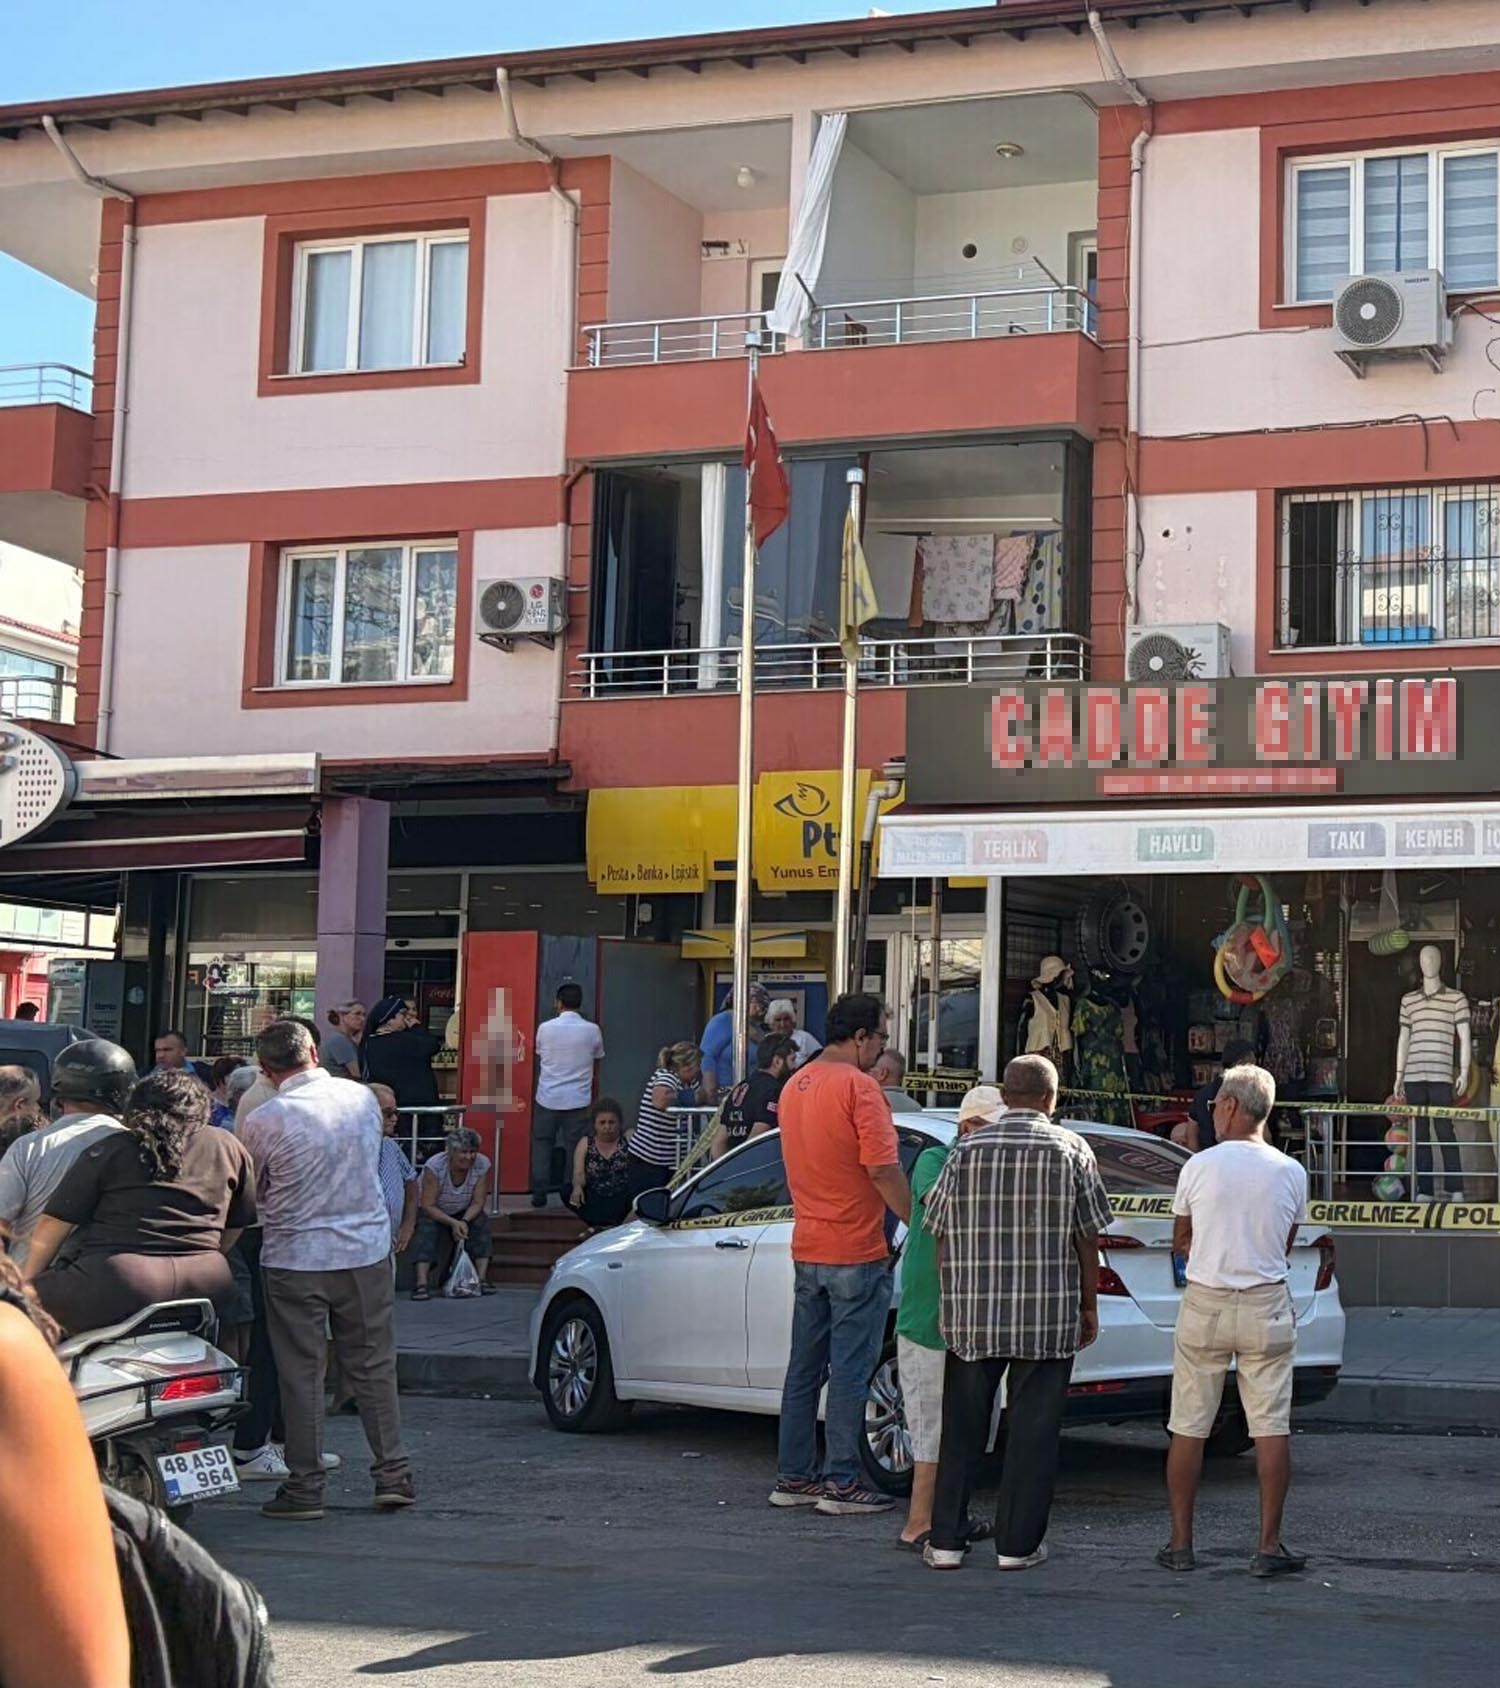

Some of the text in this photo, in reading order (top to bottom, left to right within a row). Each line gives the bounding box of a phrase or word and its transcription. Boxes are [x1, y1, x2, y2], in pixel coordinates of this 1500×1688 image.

[991, 687, 1211, 768] CADDE
[803, 820, 841, 857] Pt
[983, 838, 1039, 858] TERLİK
[1149, 833, 1202, 854] HAVLU
[1328, 830, 1365, 850] TAKI
[1405, 828, 1464, 848] KEMER
[607, 864, 699, 881] Posta Banka Lojistik
[771, 866, 839, 878] Yunus Em
[1108, 1197, 1174, 1213] RİLME
[1310, 1204, 1421, 1224] GİRİLMEZ
[164, 1448, 228, 1473] 48 ASD
[196, 1466, 233, 1488] 964
